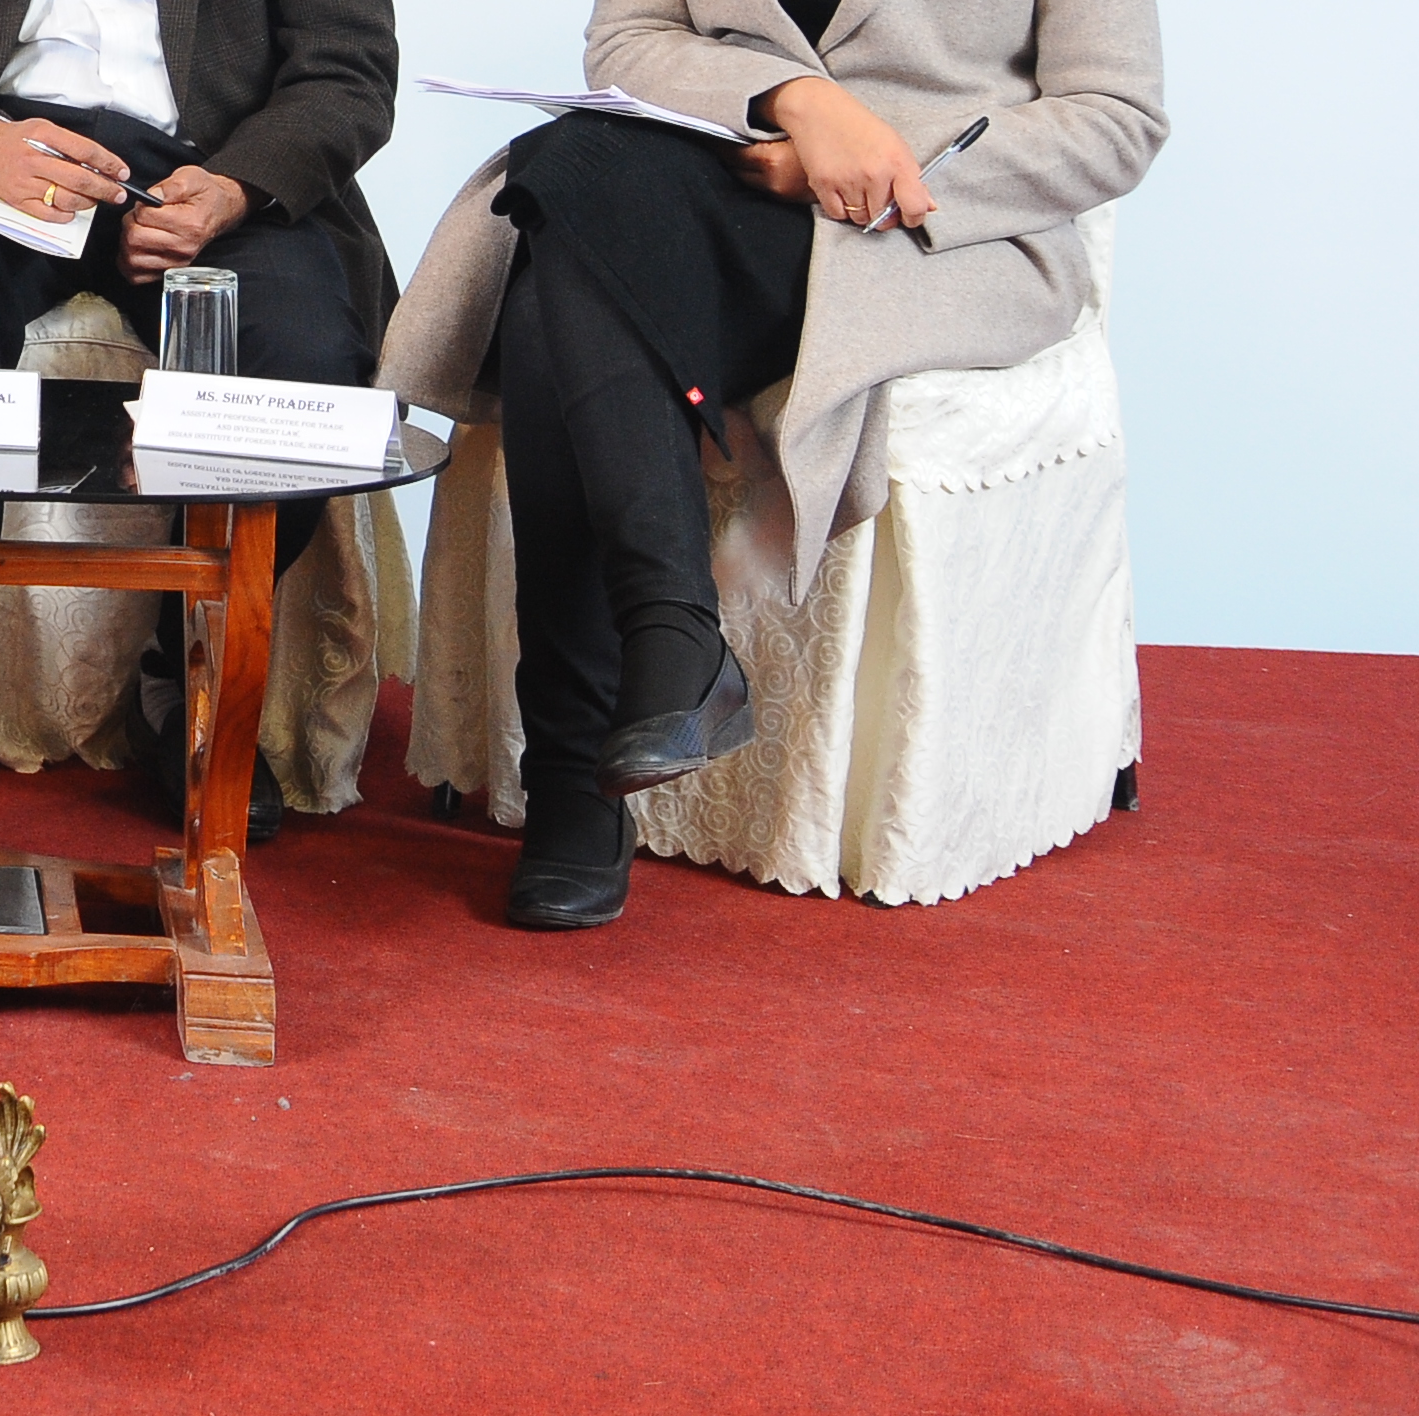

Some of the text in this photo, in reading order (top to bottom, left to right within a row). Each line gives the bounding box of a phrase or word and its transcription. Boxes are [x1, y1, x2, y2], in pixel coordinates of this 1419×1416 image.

[195, 390, 336, 413] MS. SHINY PRADEEP
[180, 409, 222, 420] ASSISTANT
[270, 417, 300, 427] CENTRE
[301, 420, 317, 429] FOR
[318, 422, 345, 431] TRADE
[168, 430, 193, 439] INDIAN
[194, 432, 232, 442] INSTITUTE
[233, 435, 244, 443] OF
[216, 423, 232, 431] AND
[233, 425, 280, 436] INVESTMENT
